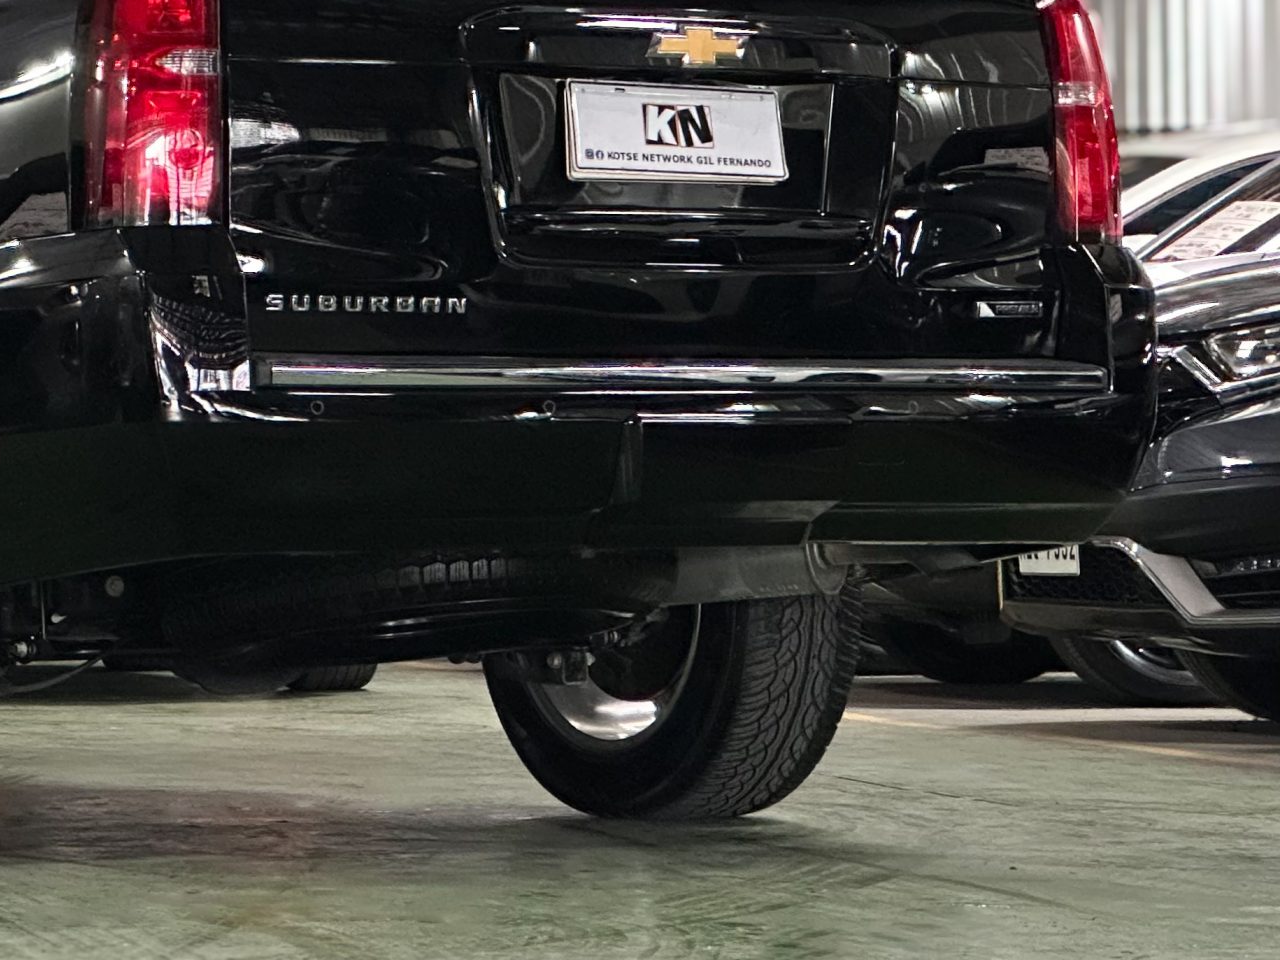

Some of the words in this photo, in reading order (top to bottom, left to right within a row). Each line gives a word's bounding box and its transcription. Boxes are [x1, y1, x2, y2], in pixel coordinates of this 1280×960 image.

[642, 103, 715, 148] KN
[606, 151, 639, 162] KOTSE
[641, 153, 693, 164] NETWORK
[696, 155, 715, 166] GIL
[716, 157, 772, 168] FERNANDO
[265, 294, 468, 314] SUBURBAN
